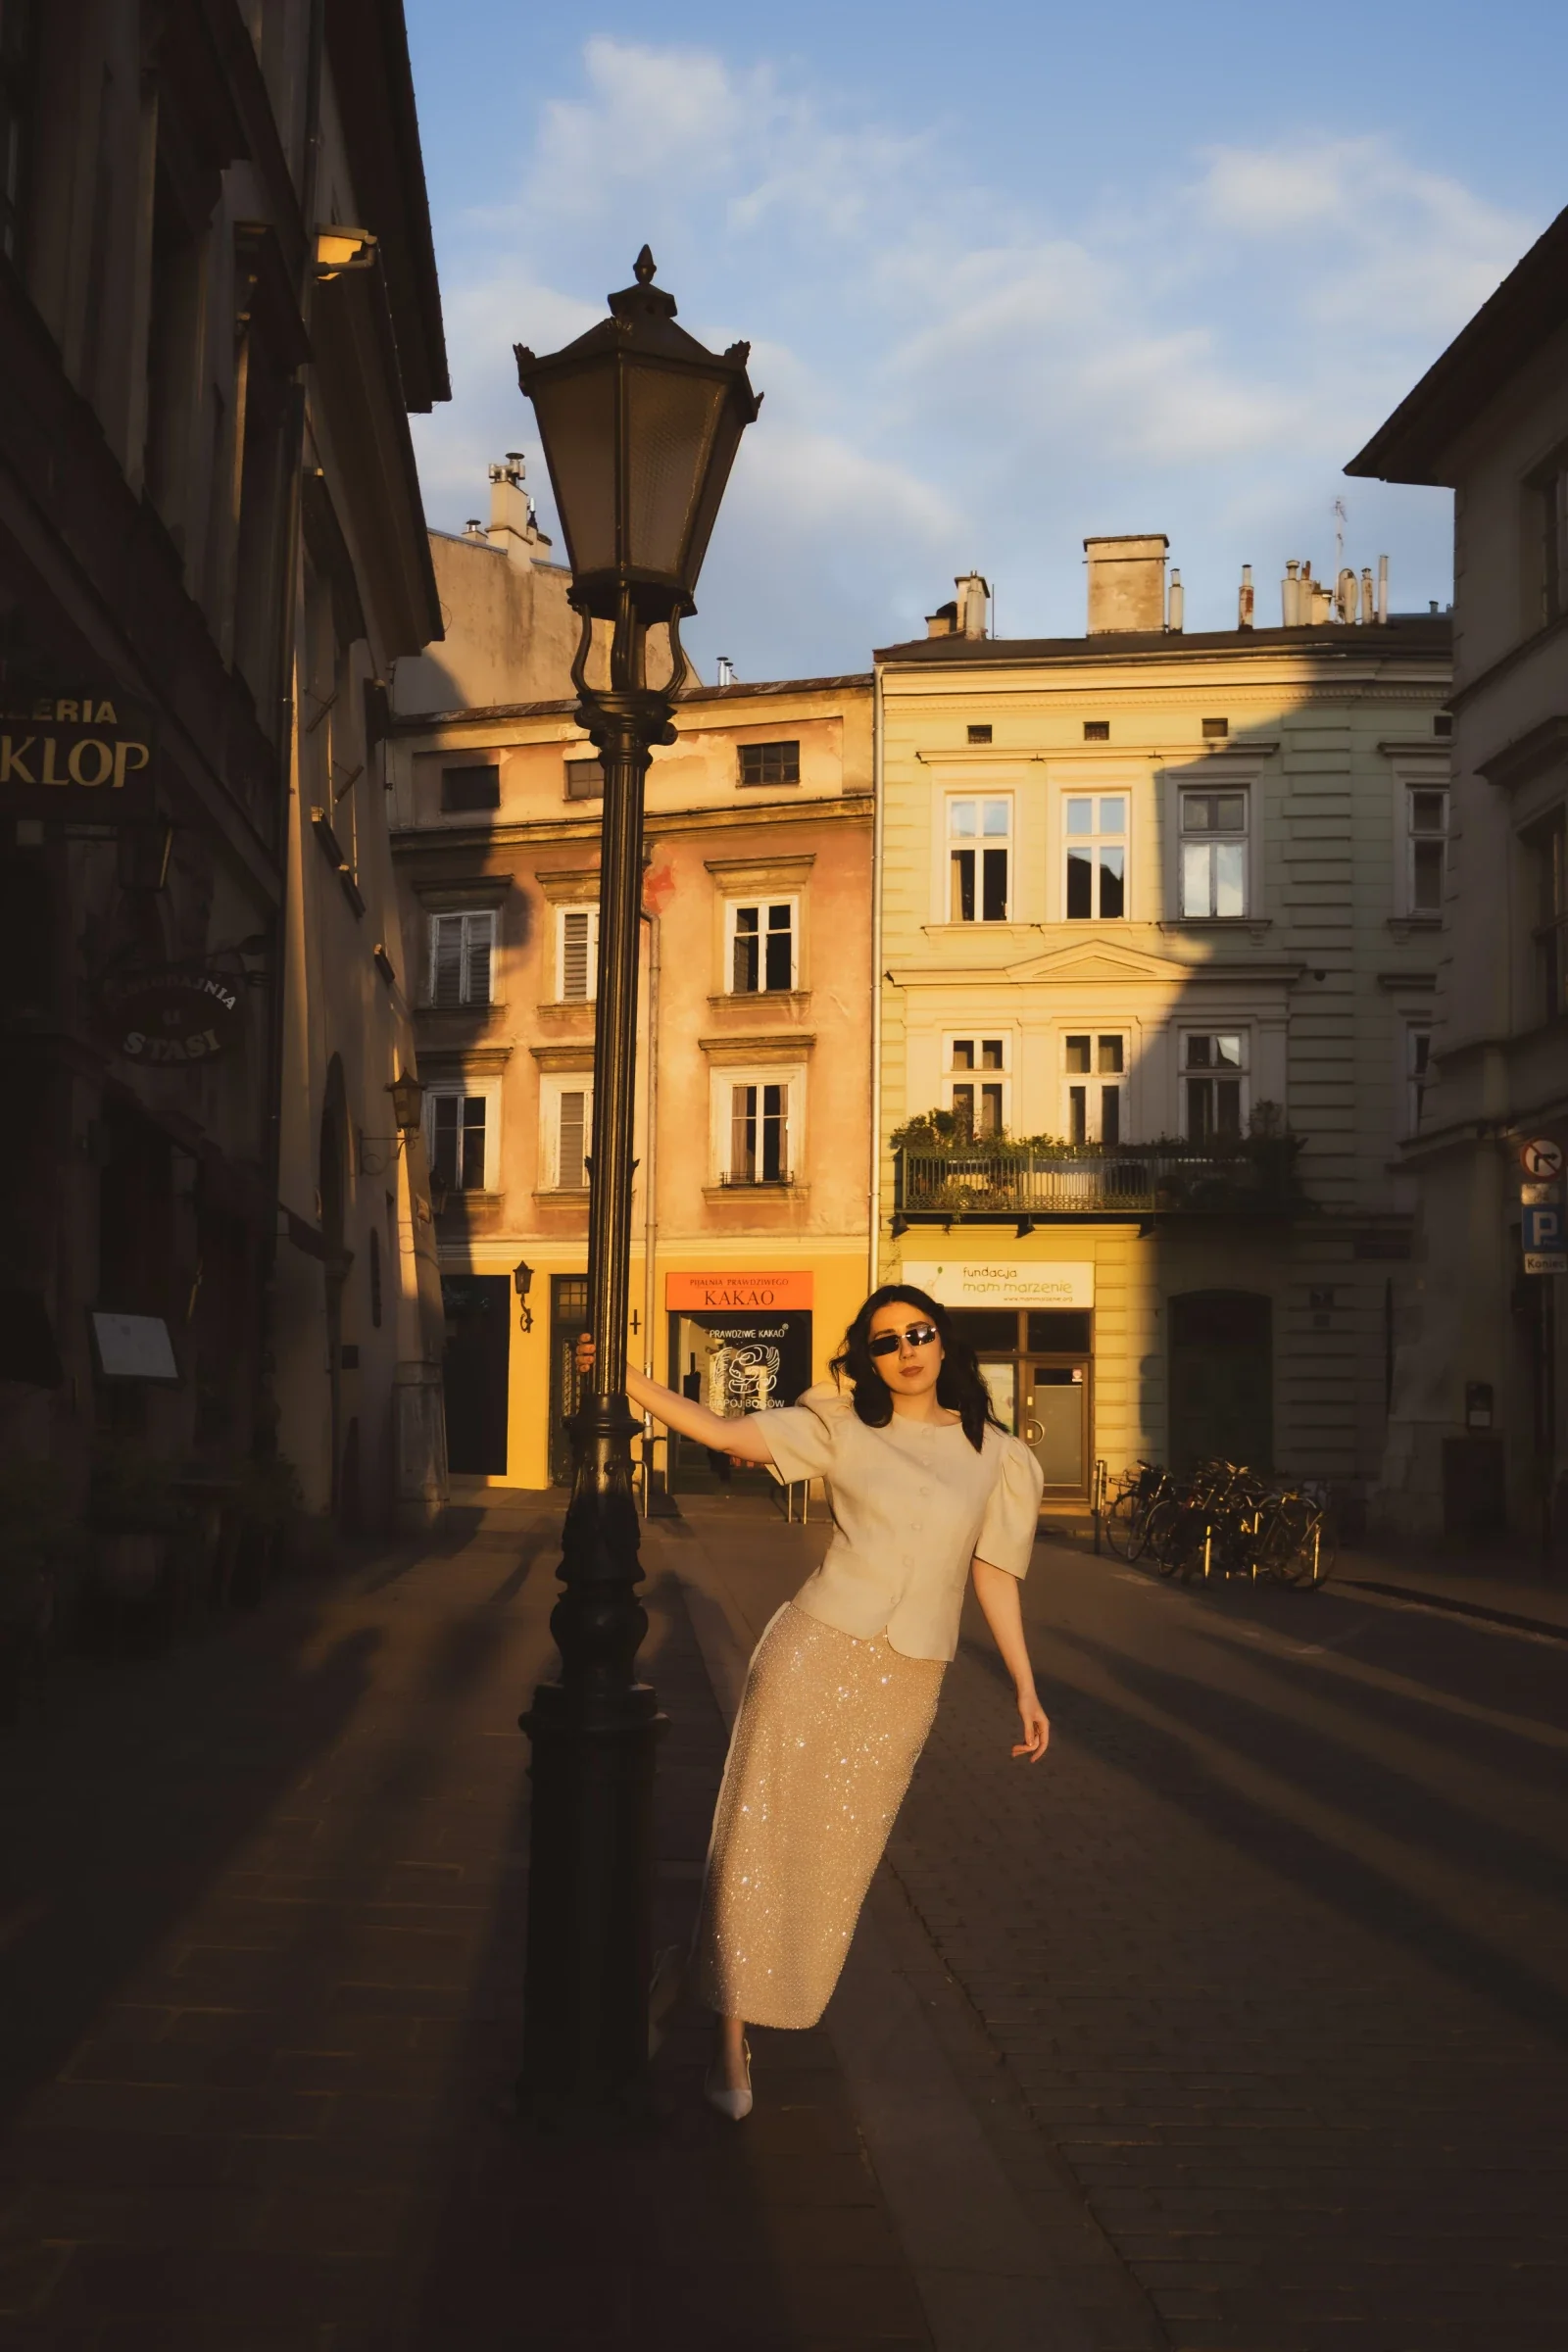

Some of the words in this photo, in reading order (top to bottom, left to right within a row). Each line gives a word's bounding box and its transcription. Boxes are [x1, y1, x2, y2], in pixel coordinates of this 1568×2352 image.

[0, 698, 118, 724] ERIA
[0, 735, 150, 788] KLOP
[122, 1028, 221, 1061] STASI
[1533, 1211, 1558, 1247] P
[1527, 1257, 1565, 1269] Koniec
[963, 1266, 1017, 1279] fundacja
[962, 1282, 1001, 1292] mam
[1004, 1280, 1073, 1293] marzenie
[705, 1290, 774, 1305] KAKAO
[710, 1329, 757, 1339] PRAWDZIWE
